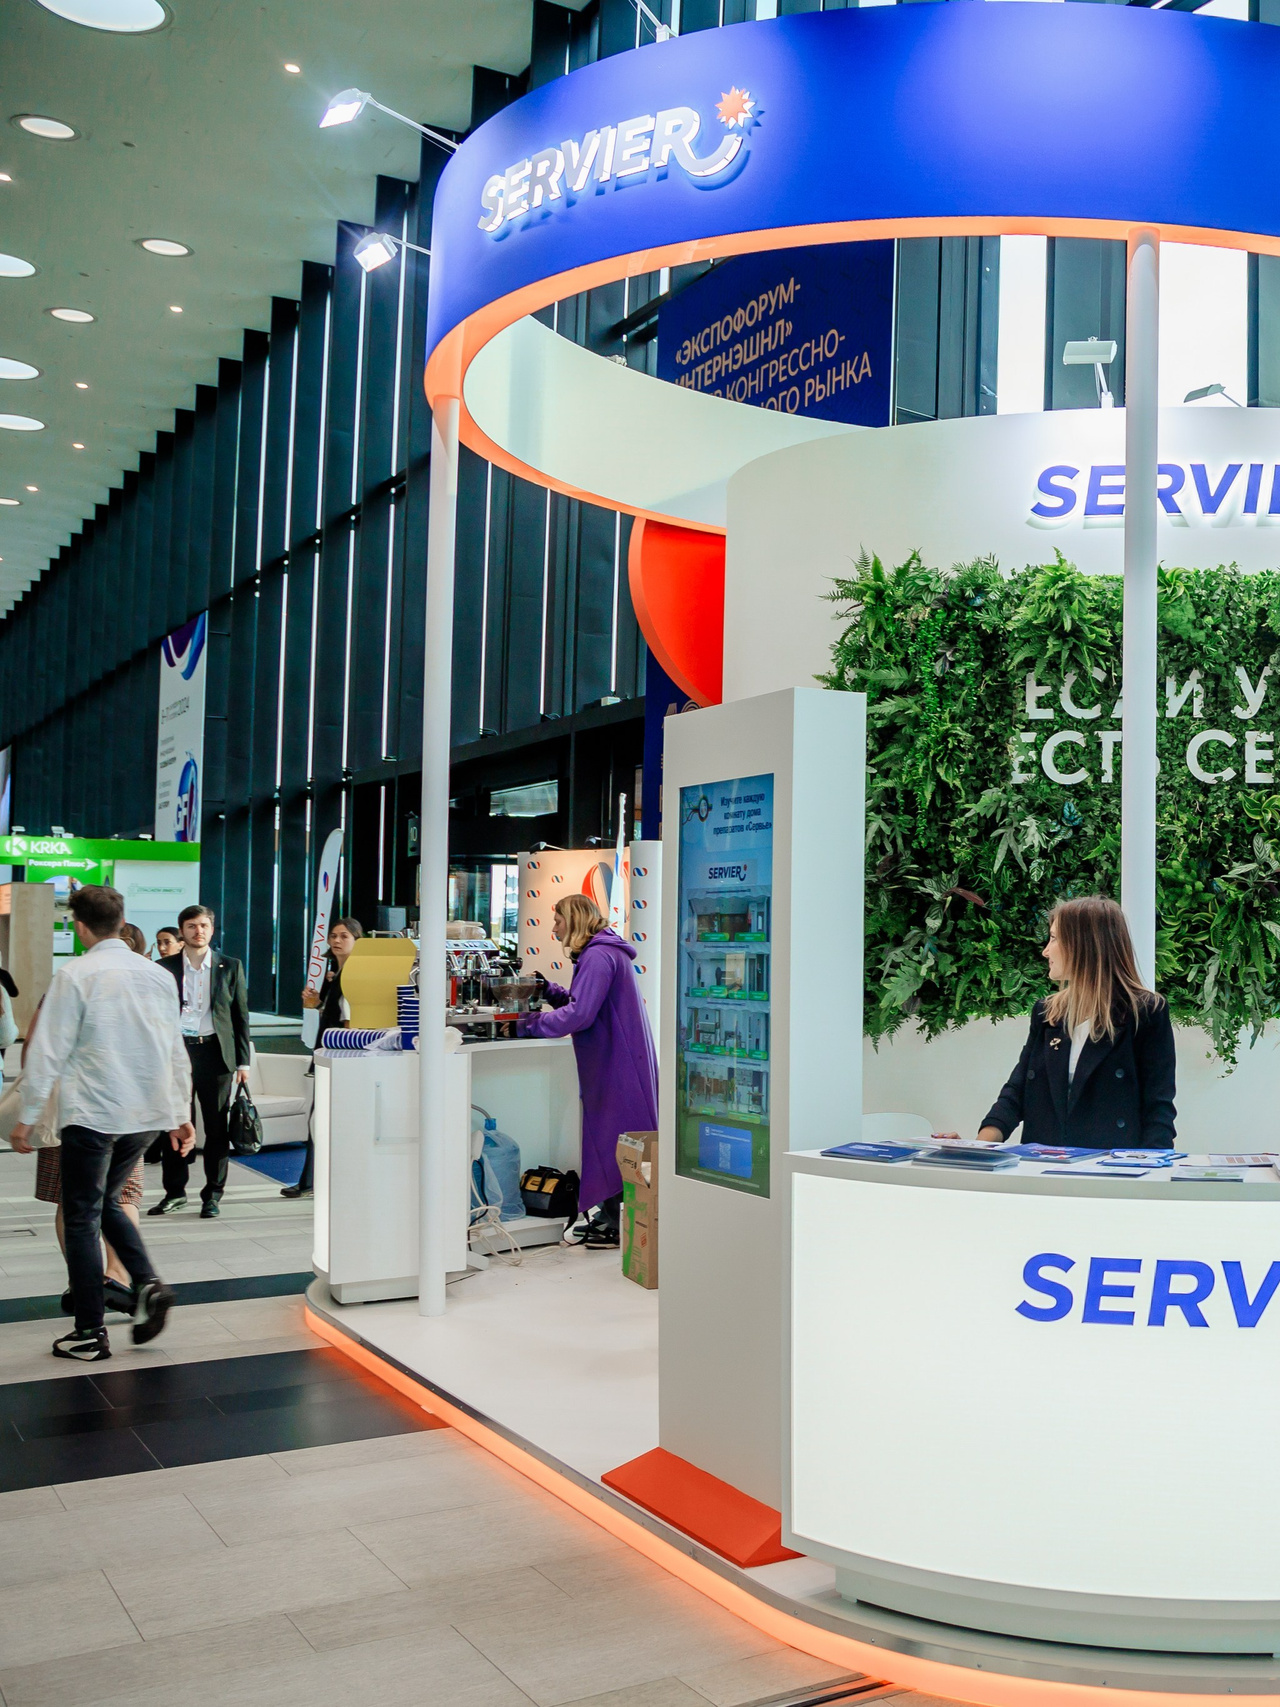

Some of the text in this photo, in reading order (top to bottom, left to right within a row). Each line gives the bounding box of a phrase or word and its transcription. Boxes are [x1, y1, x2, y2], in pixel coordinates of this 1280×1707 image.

[477, 106, 743, 232] SERVIER
[675, 277, 801, 365] «ЭКСПОФОРУМ-
[726, 328, 846, 403] КОНГРЕССНО-
[804, 351, 872, 407] РЫНКА
[1025, 666, 1204, 720] ЕСИ
[1231, 665, 1273, 720] У
[1010, 729, 1161, 785] ЕСТ
[720, 793, 765, 808] Изучите каждую
[746, 808, 762, 819] дома
[31, 841, 72, 855] KRKA
[708, 866, 747, 881] SERVIER
